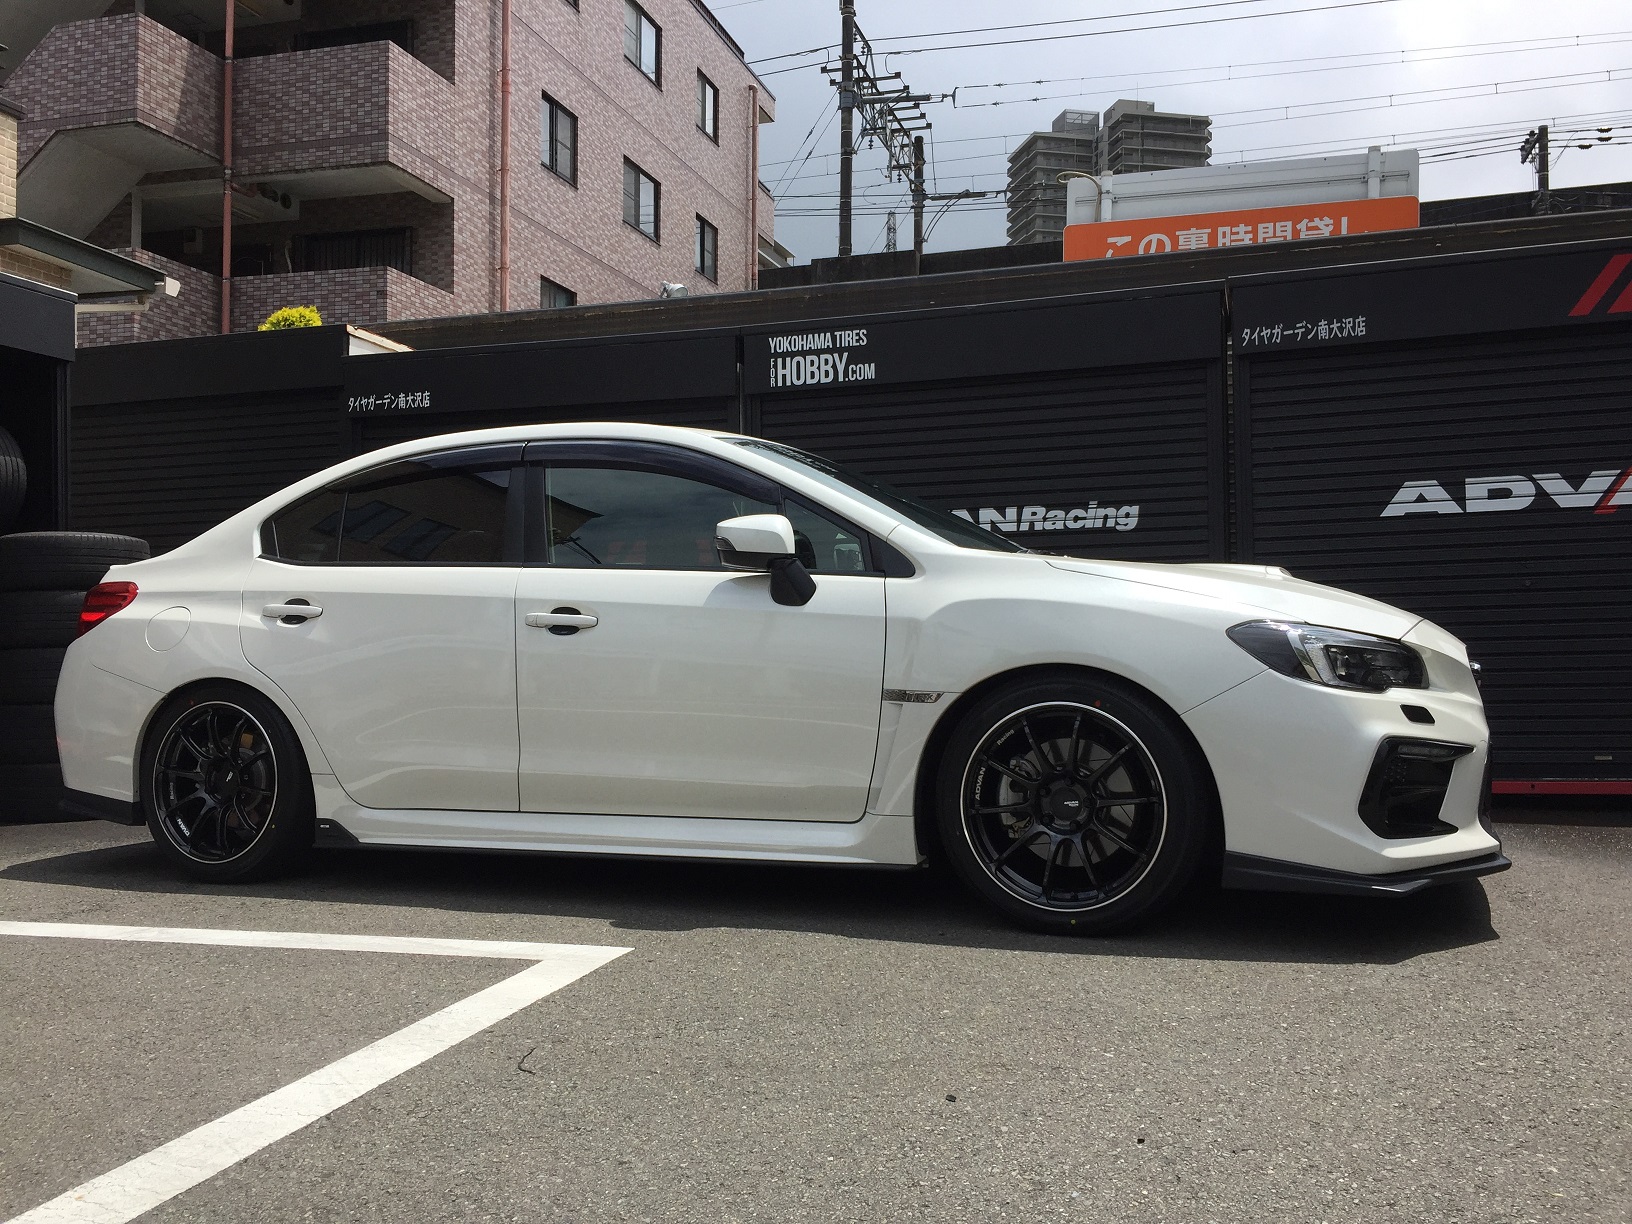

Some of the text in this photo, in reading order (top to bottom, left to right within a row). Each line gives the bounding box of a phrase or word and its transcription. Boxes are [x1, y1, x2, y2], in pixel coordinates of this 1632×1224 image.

[769, 329, 867, 353] YOKOHAMA TIRES
[1241, 316, 1366, 346] タイヤガーデン南大沢店
[777, 352, 875, 386] HOBBY.COM
[348, 391, 430, 412] タイヤガーデン南大沢店
[1019, 501, 1140, 532] Racing
[974, 766, 986, 801] ADVAN
